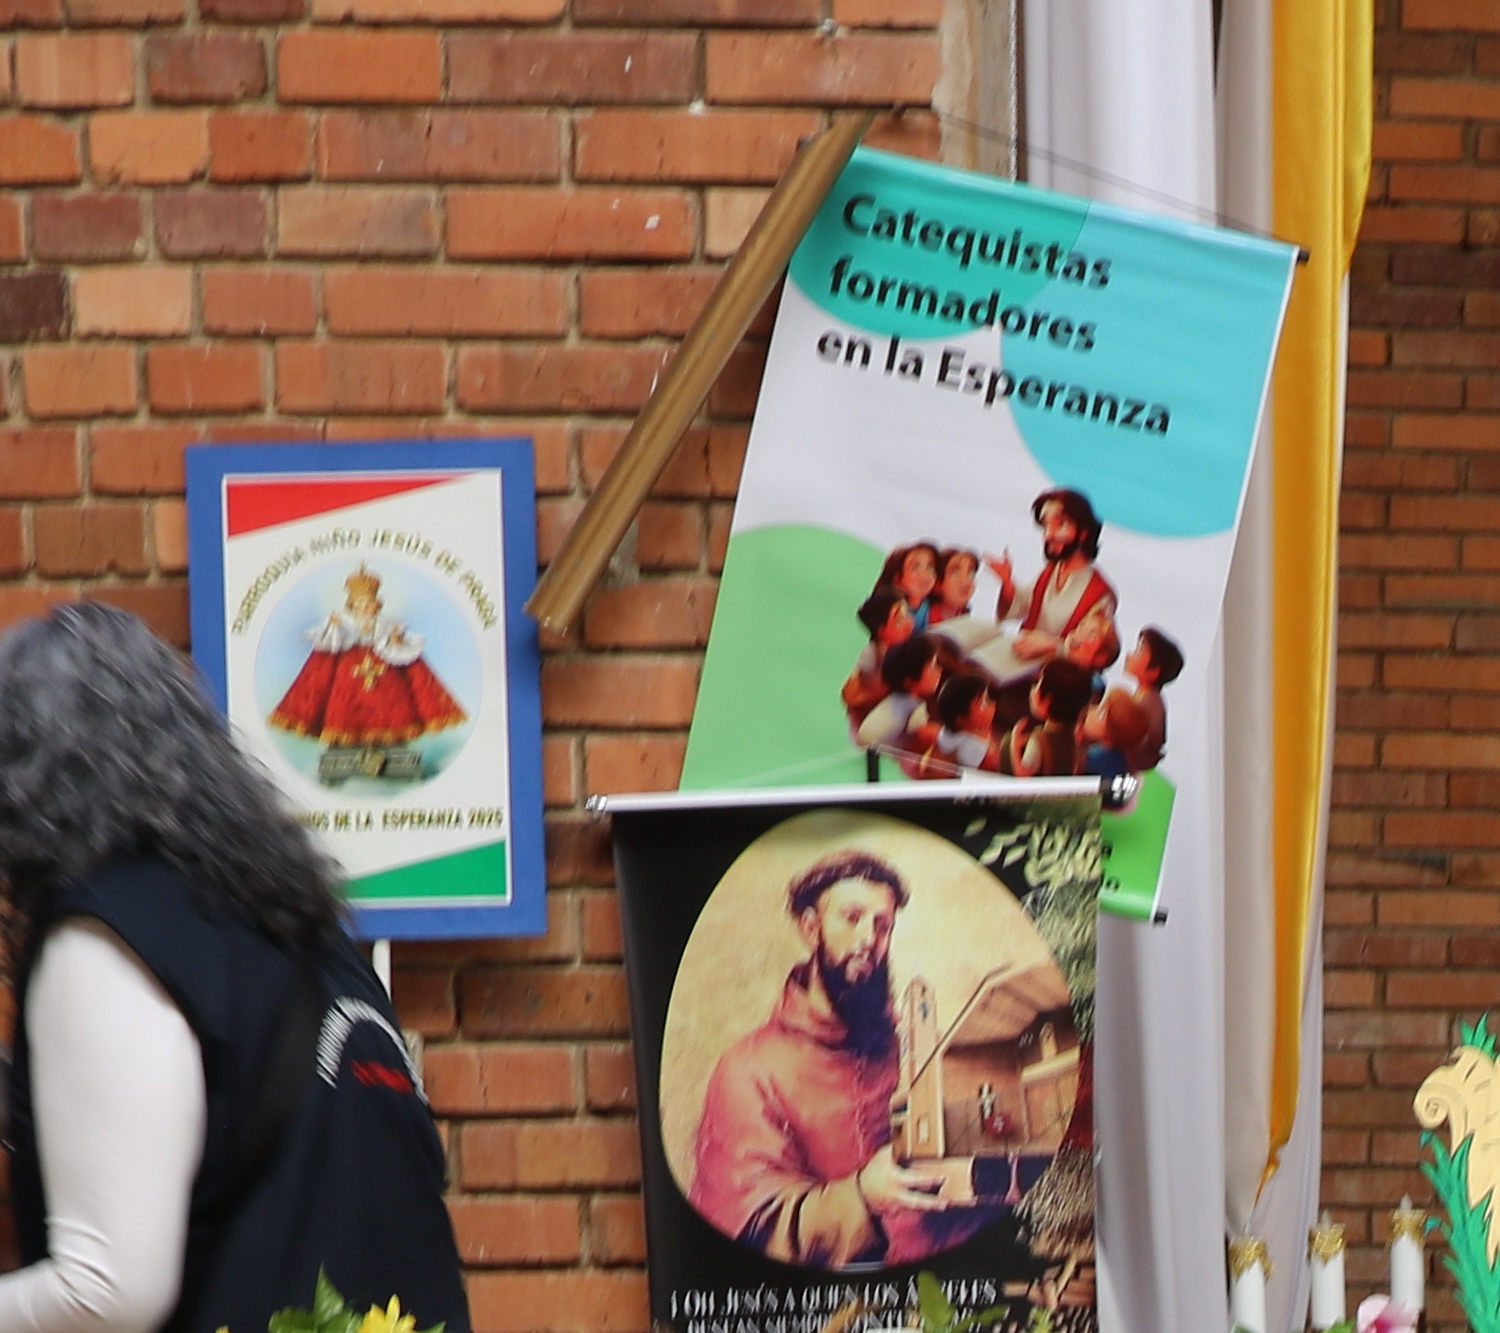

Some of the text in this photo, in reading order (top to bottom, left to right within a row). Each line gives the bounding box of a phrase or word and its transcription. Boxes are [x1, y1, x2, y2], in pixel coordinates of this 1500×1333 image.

[841, 192, 1113, 290] Catequistas
[828, 253, 1098, 352] formadores
[815, 328, 1172, 438] en la Esperanza
[382, 807, 462, 831] ESPERANZA
